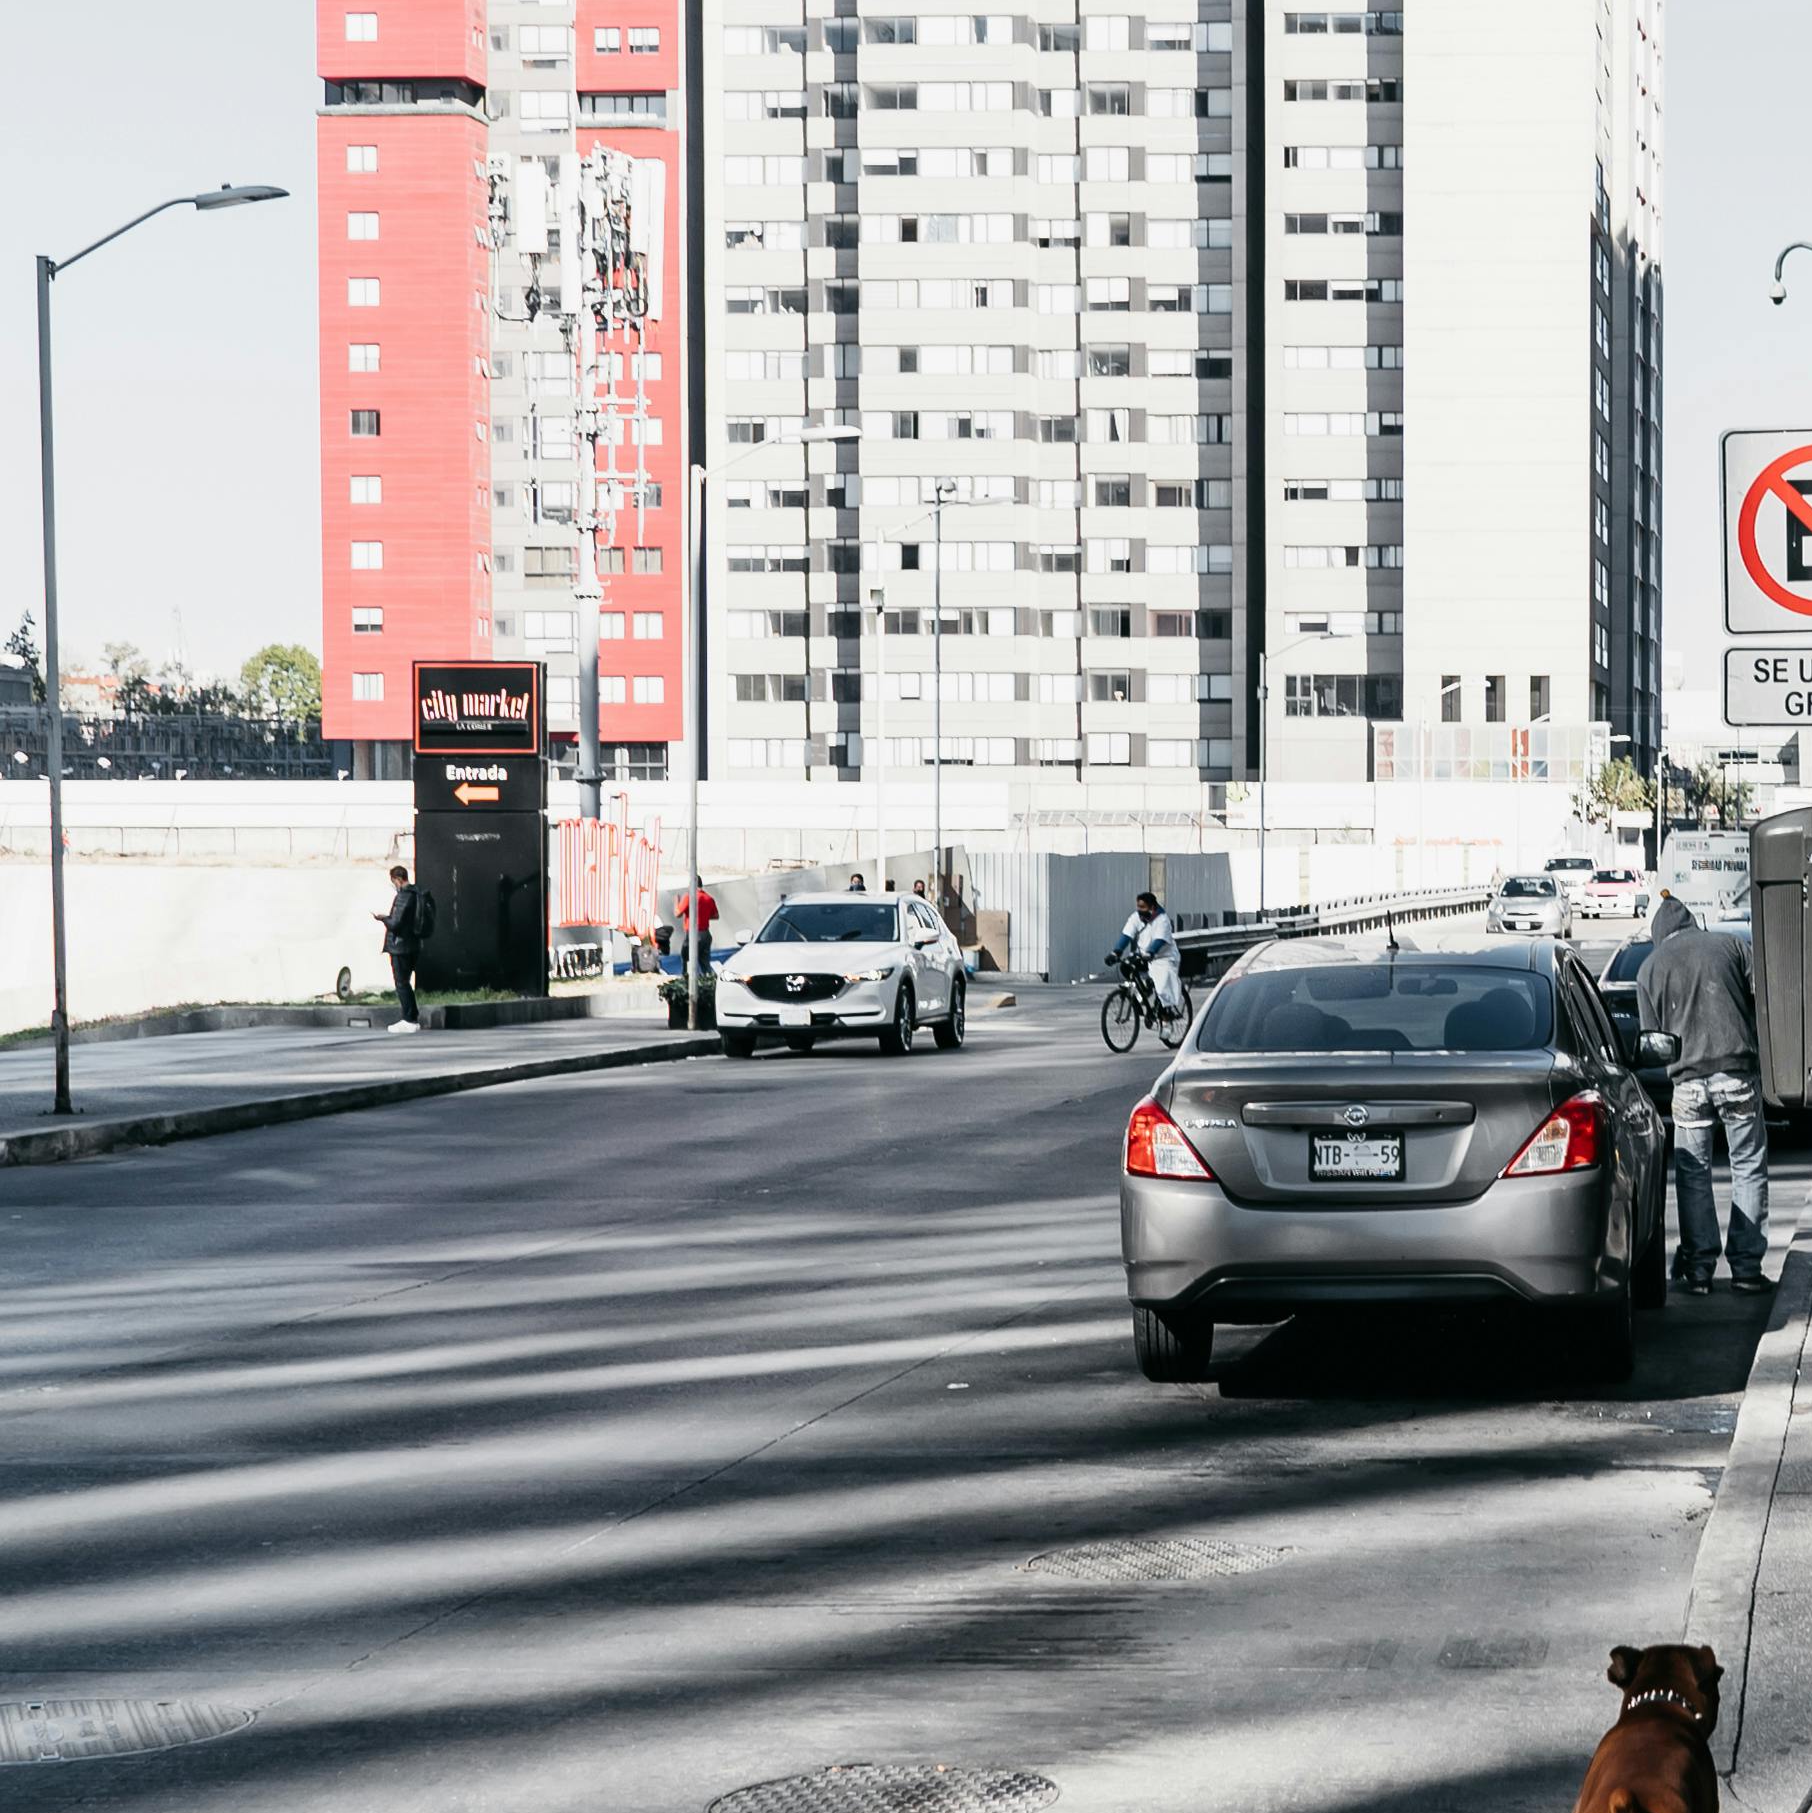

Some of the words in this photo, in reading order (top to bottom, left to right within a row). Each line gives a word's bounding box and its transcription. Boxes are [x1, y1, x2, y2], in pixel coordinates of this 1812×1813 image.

[1753, 658, 1789, 683] SE
[421, 690, 458, 723] city
[463, 688, 529, 720] market
[446, 764, 508, 780] Entrada
